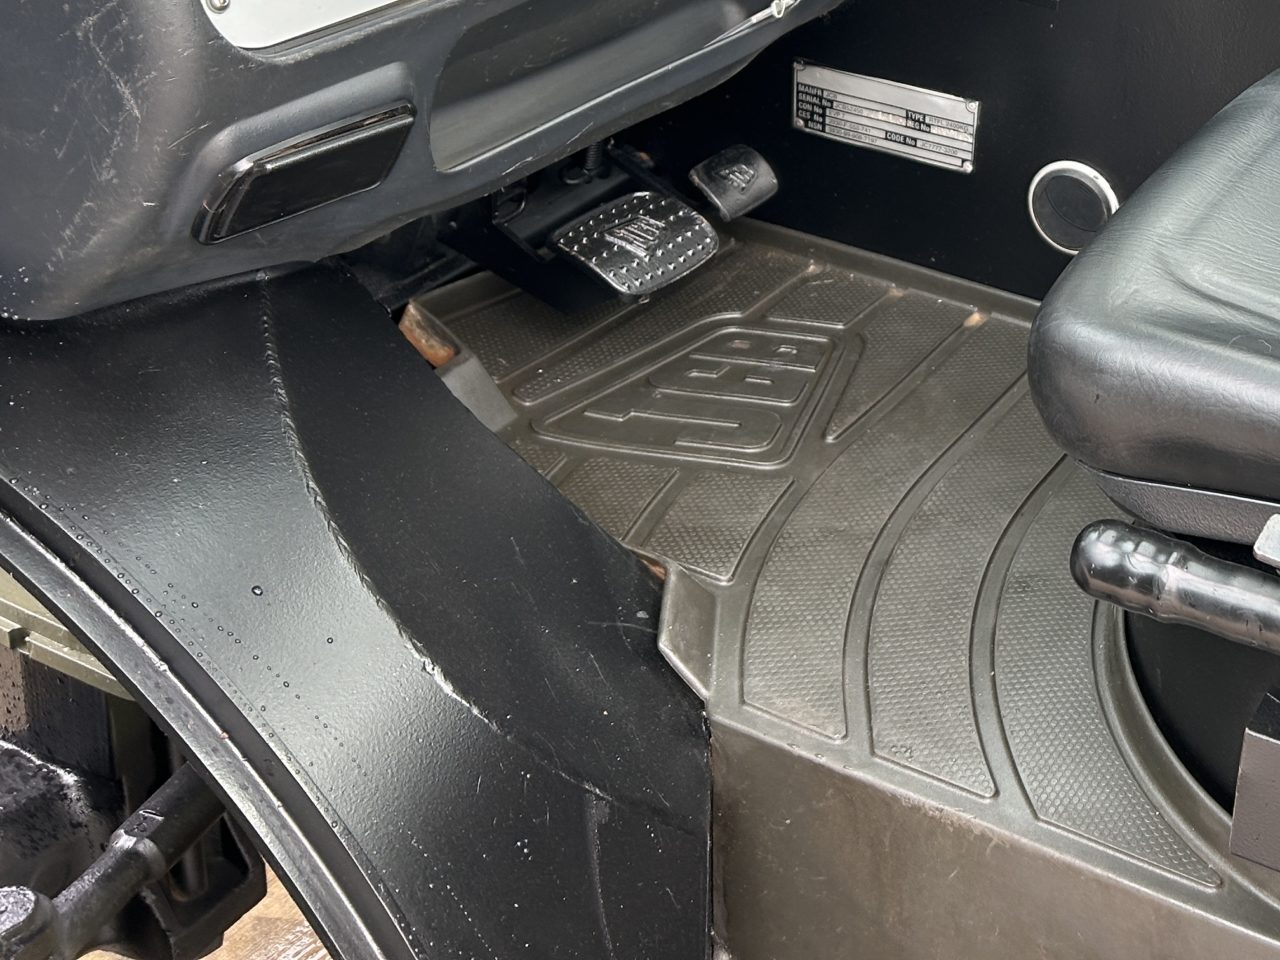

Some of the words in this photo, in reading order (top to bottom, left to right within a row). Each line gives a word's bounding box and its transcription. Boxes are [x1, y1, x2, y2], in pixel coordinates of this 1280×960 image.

[798, 92, 821, 105] SERIAL
[908, 111, 925, 122] TYPE
[887, 132, 905, 143] CODE
